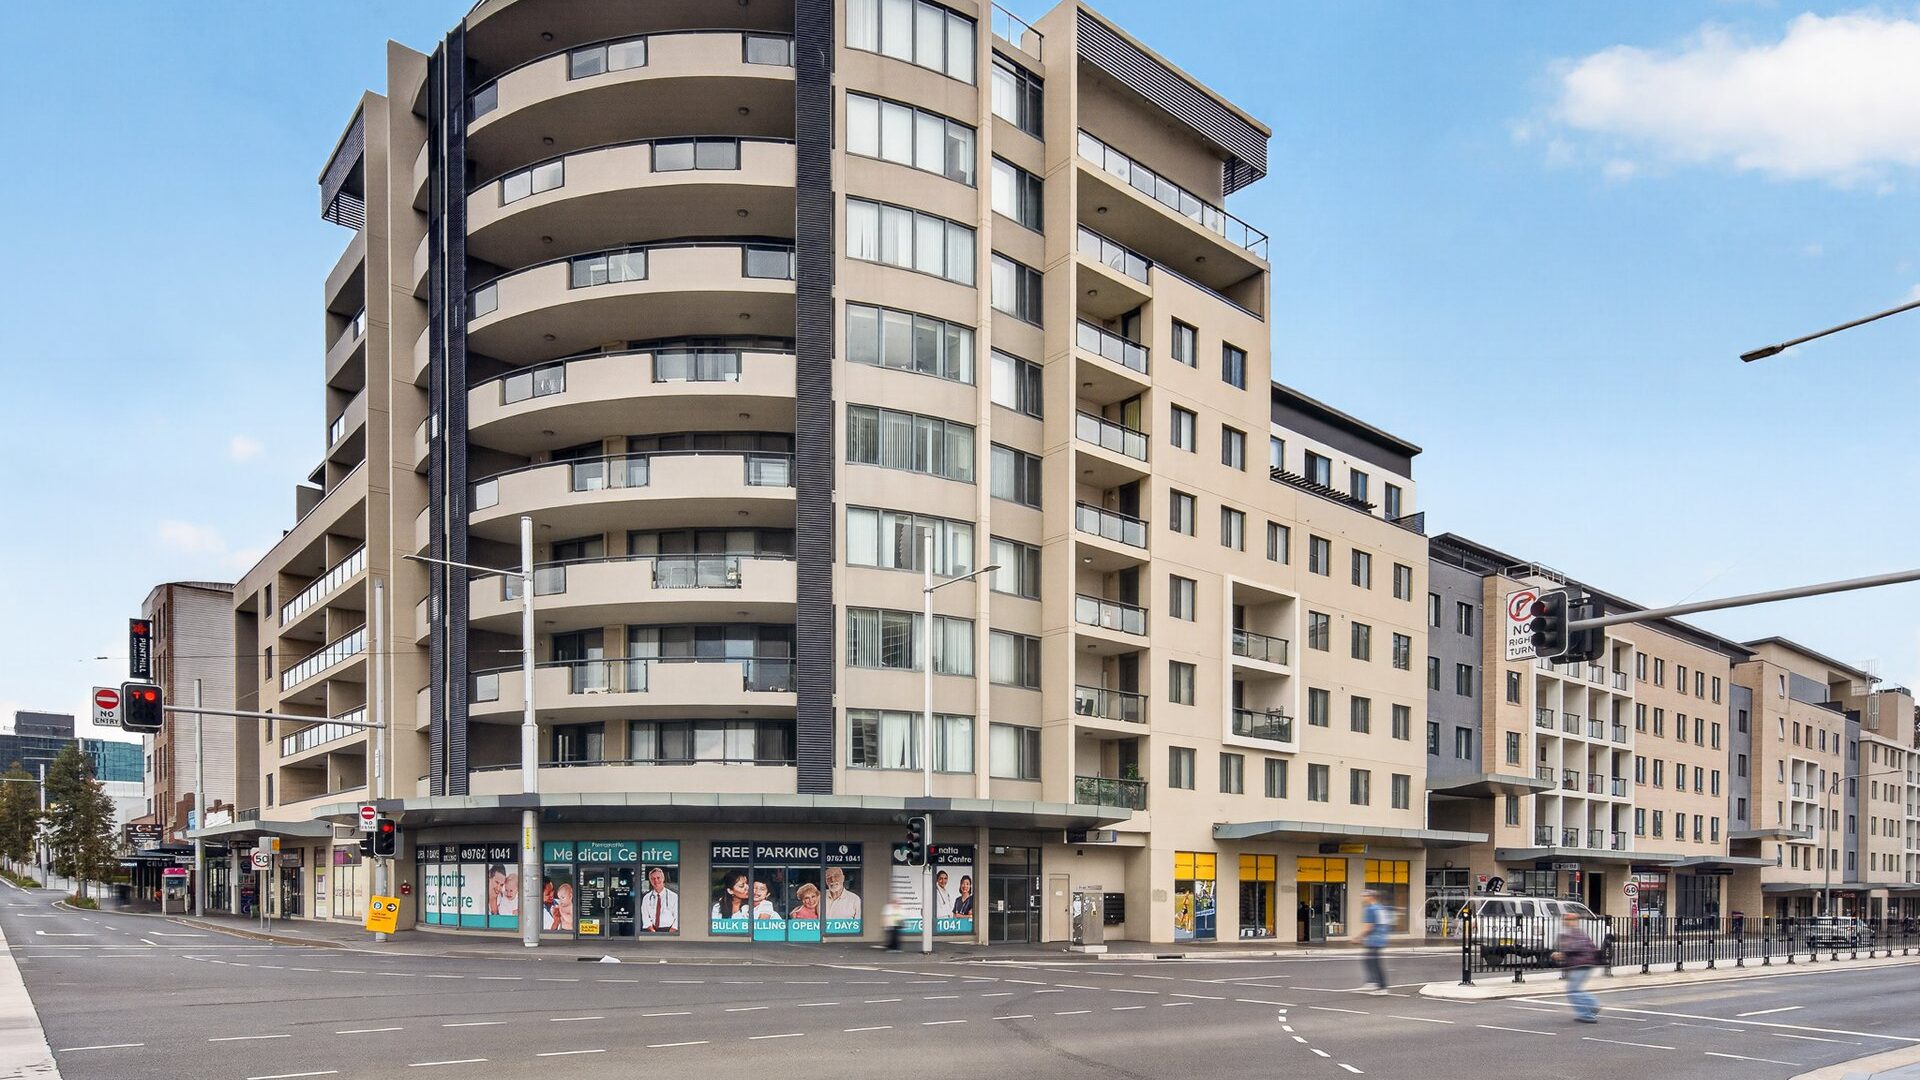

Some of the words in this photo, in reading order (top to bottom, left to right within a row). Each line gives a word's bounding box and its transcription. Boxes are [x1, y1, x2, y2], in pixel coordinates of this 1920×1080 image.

[1513, 623, 1531, 636] NO
[1509, 636, 1531, 646] RIGH
[1510, 646, 1535, 656] TURN
[467, 848, 486, 859] 9762
[490, 847, 511, 859] 1041
[553, 848, 612, 861] Medical
[618, 848, 673, 861] Centre
[713, 846, 749, 858] FREE
[756, 846, 819, 858] PARKING
[255, 855, 269, 863] 50
[947, 855, 972, 863] Centre
[712, 921, 738, 930] BULK
[741, 921, 786, 930] BILLING
[792, 921, 820, 930] OPEN
[826, 921, 831, 930] 7
[834, 921, 859, 930] DAYS
[937, 920, 961, 930] 1041
